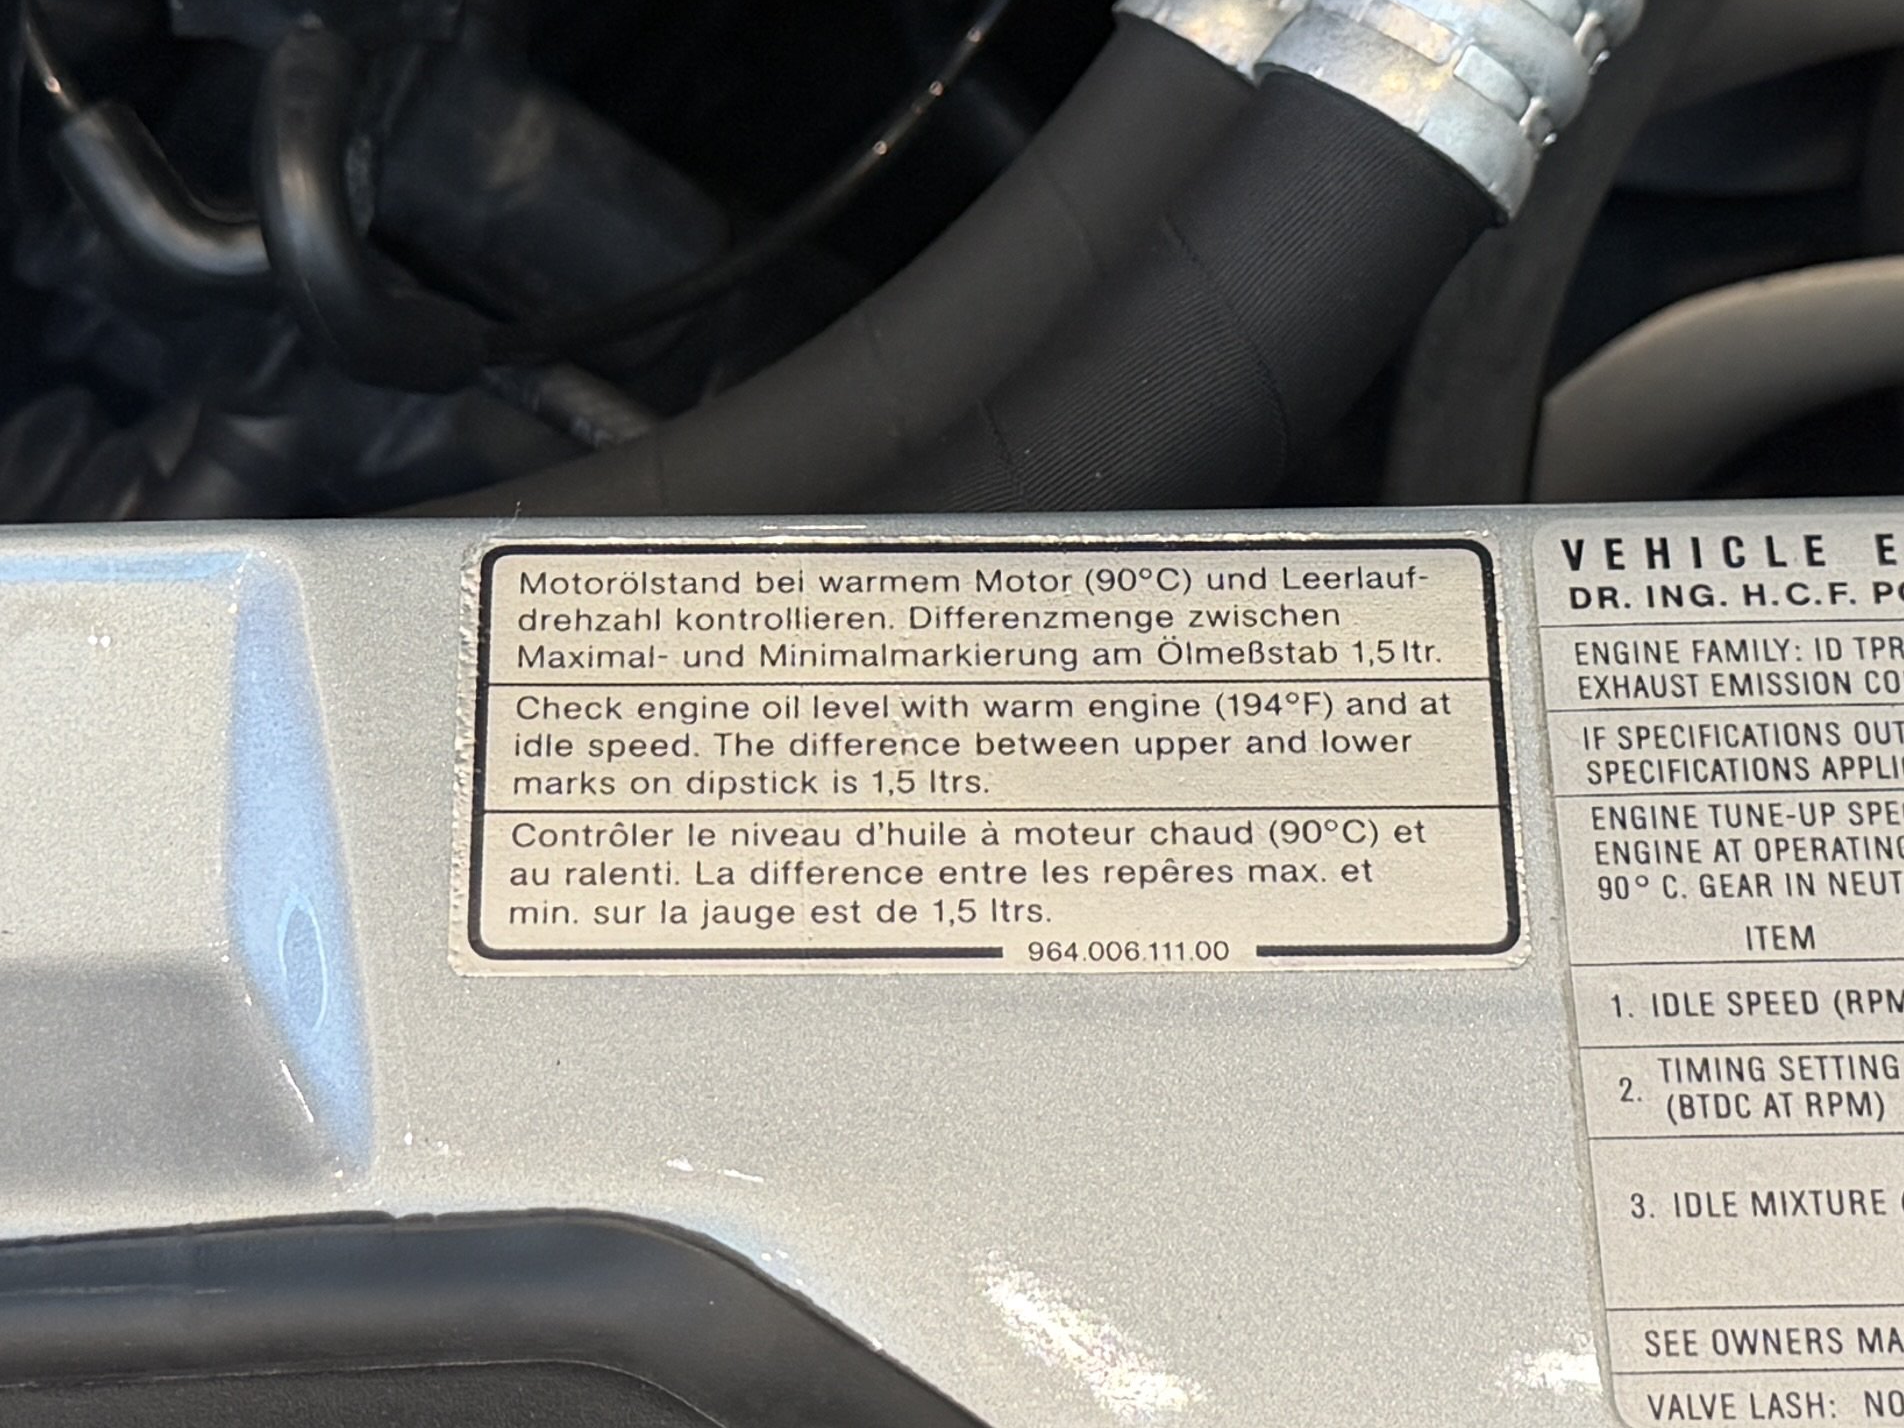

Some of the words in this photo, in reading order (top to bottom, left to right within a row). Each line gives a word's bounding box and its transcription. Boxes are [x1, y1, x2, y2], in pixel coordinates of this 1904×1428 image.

[1559, 533, 1826, 572] VEHICLE
[519, 570, 740, 595] Motorölstand
[755, 568, 804, 594] bei
[818, 574, 960, 594] warmem
[974, 568, 1073, 593] Motor
[1206, 565, 1267, 591] und
[1281, 564, 1428, 590] Leerlauf-
[1568, 585, 1631, 610] DR.
[1645, 582, 1727, 608] ING.
[1741, 580, 1857, 607] H.C.F.
[517, 607, 661, 632] drehzahl
[675, 605, 894, 631] kontrollieren.
[908, 604, 1174, 634] Differenzmenge
[1187, 602, 1340, 628] zwischen
[517, 644, 668, 669] Maximal-
[682, 643, 744, 668] und
[759, 641, 1078, 672] Minimalmarkierung
[1091, 646, 1142, 667] am
[1156, 634, 1338, 666] Ölmeßstab
[1351, 638, 1396, 667] 1,5
[1401, 638, 1441, 664] ltr.
[1573, 638, 1680, 666] ENGINE
[1690, 636, 1802, 664] FAMILY:
[1577, 672, 1699, 700] EXHAUST
[1709, 669, 1852, 697] EMISSION
[515, 694, 622, 721] Check
[636, 694, 750, 725] engine
[761, 694, 799, 720] oil
[812, 693, 889, 720] level
[900, 693, 969, 719] with
[982, 698, 1073, 719] warm
[1087, 692, 1201, 723] engine
[1345, 690, 1407, 716] and
[1419, 691, 1451, 715] at
[1585, 755, 1810, 786] SPECIFICATIONS
[1590, 803, 1699, 831] ENGINE
[1707, 800, 1836, 829] TUNE-UP
[1027, 939, 1230, 963] 964.006.111.00
[1744, 923, 1816, 951] ITEM
[1610, 993, 1633, 1018] 1.
[1651, 990, 1715, 1018] IDLE
[1725, 989, 1819, 1017] SPEED
[1646, 1391, 1737, 1421] VALVE
[1748, 1390, 1836, 1420] LASH:
